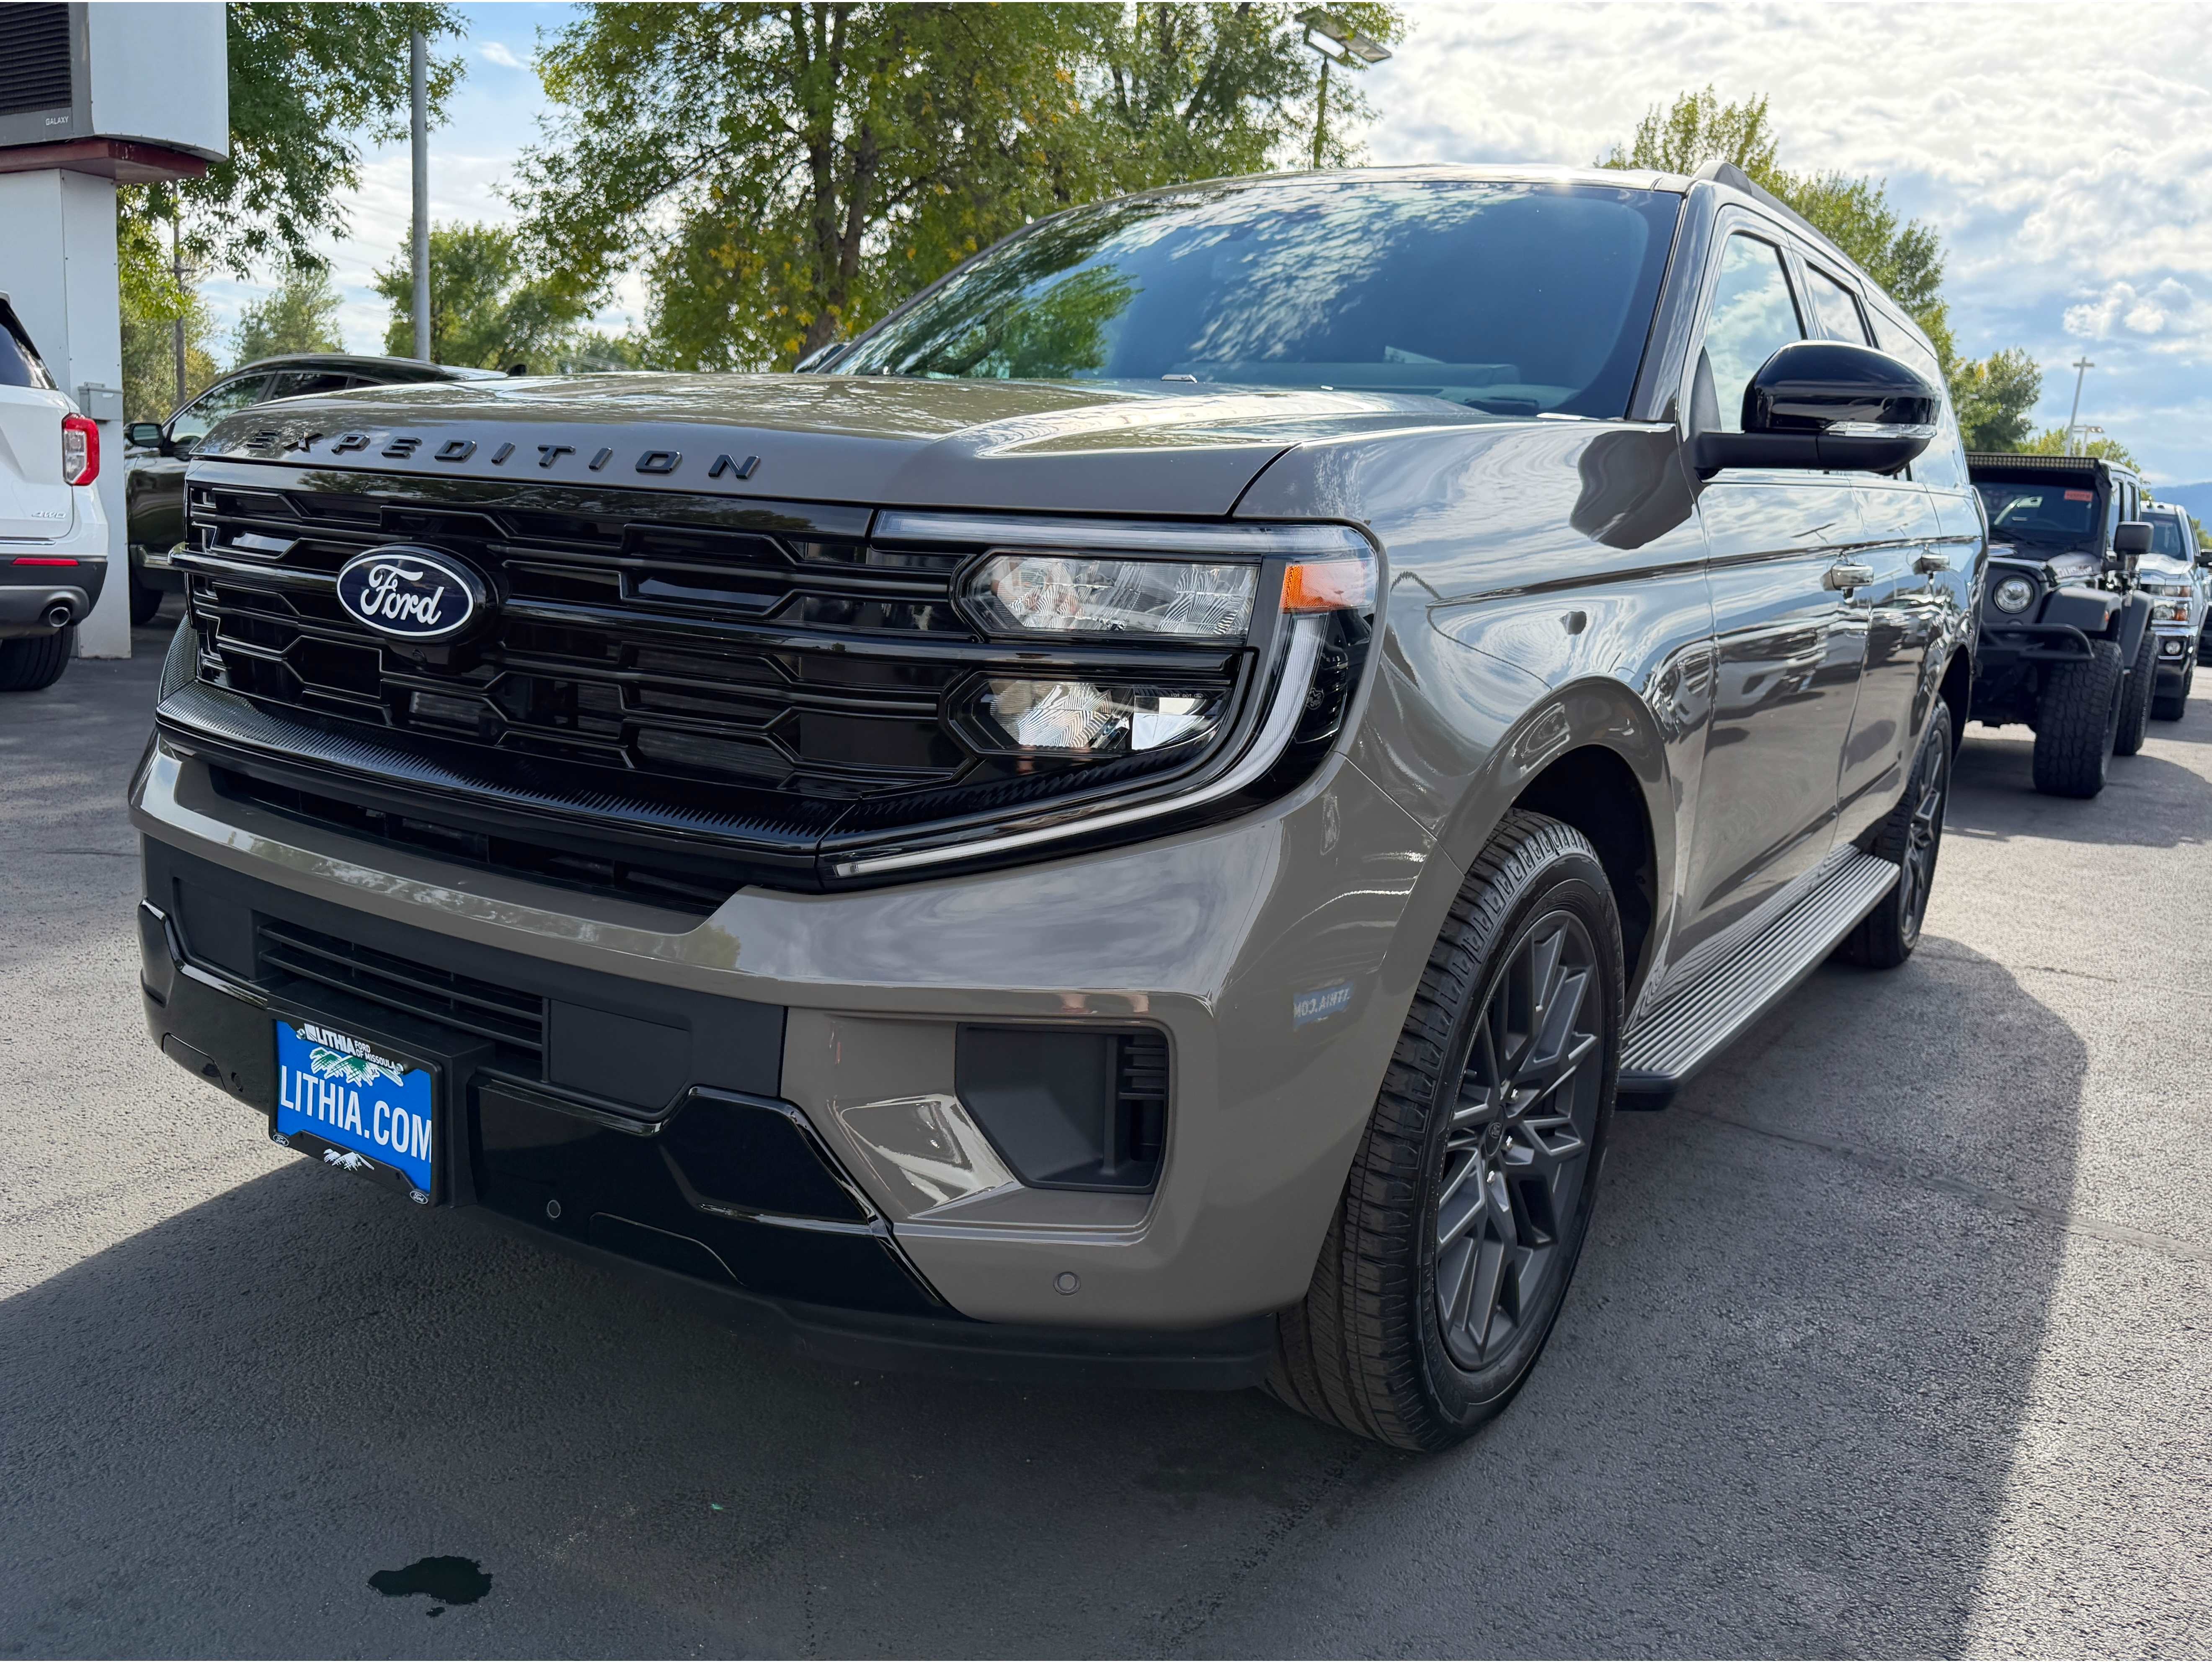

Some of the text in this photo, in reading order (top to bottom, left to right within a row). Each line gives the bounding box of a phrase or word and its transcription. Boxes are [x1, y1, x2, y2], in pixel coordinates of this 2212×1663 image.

[45, 116, 69, 126] GALAXY
[246, 429, 761, 480] EXPEDITION
[31, 511, 66, 519] 4WD
[361, 564, 444, 625] Ford
[315, 1027, 371, 1056] LITHIA FORD
[356, 1050, 395, 1069] OF MISSOULA
[281, 1065, 432, 1163] LITHIA.COM
